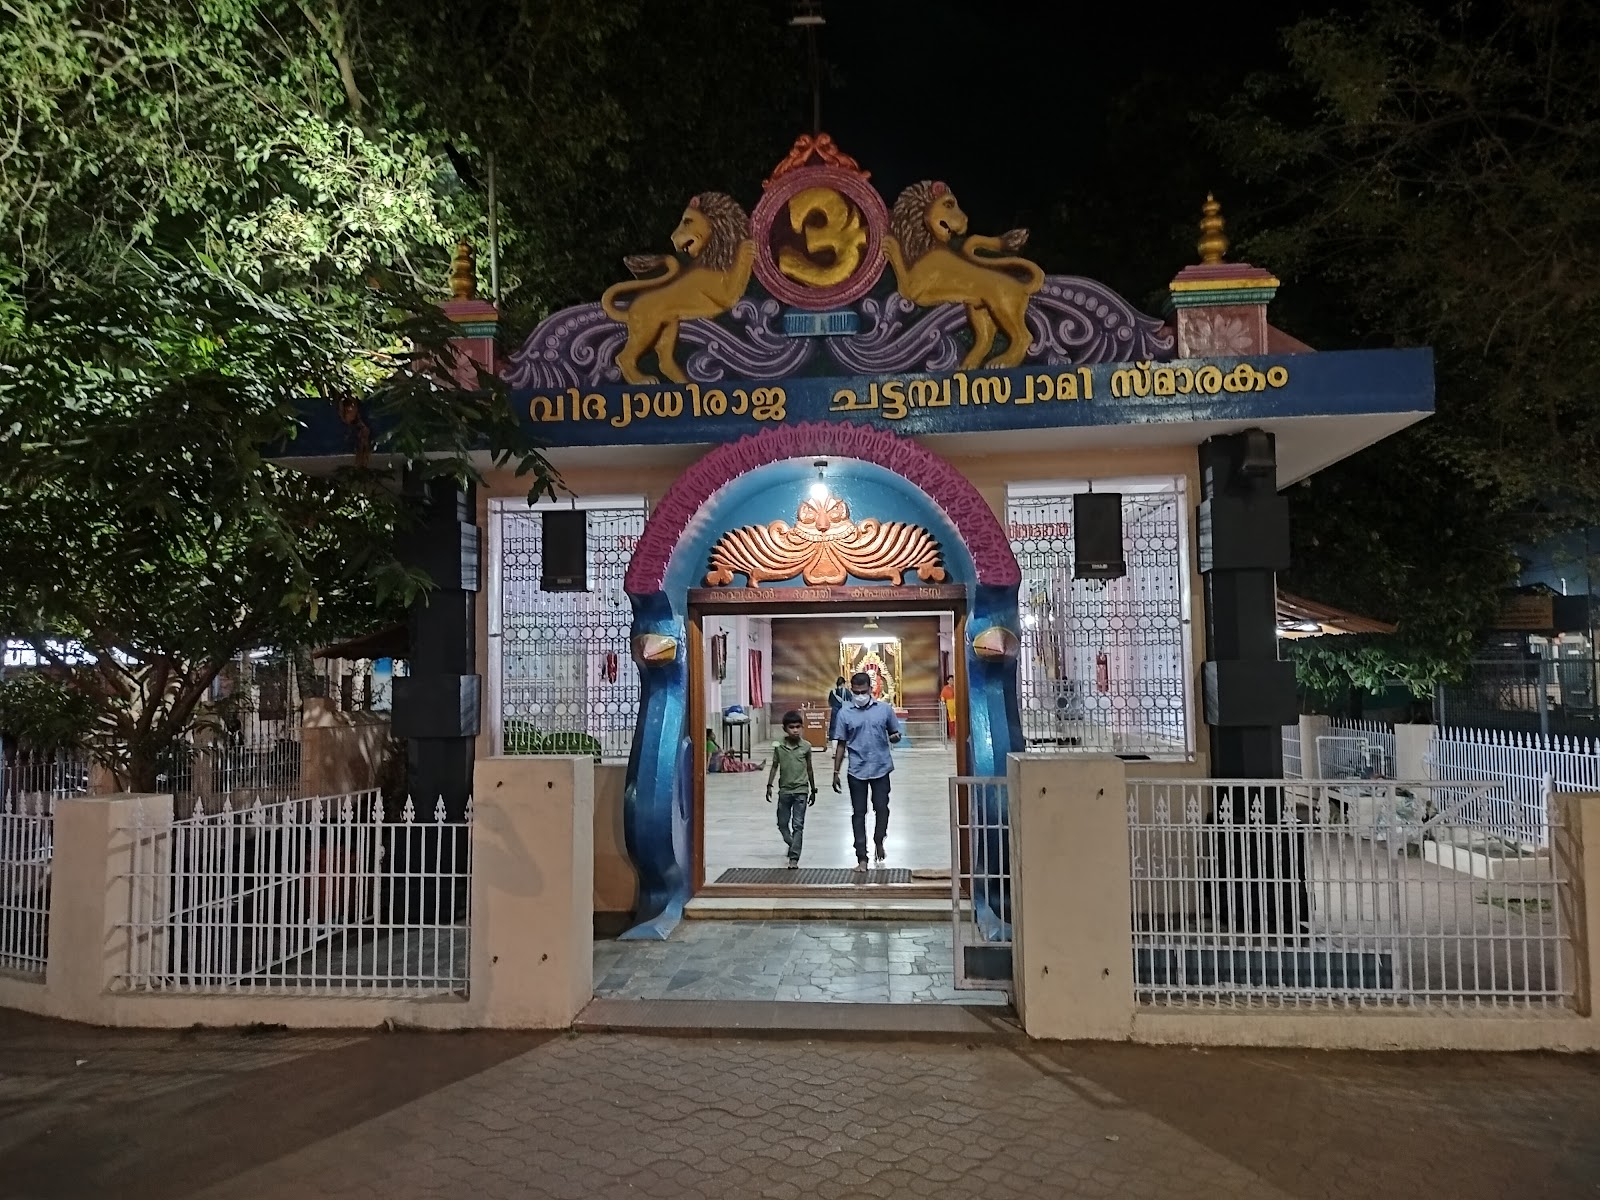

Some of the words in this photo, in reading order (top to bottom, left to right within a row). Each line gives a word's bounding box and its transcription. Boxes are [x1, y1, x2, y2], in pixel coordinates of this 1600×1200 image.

[529, 383, 786, 428] വിദ്യാധിരാജ
[829, 367, 1093, 420] ചട്ടമ്പിസ്വാമി
[1110, 360, 1289, 398] സ്മാരകം
